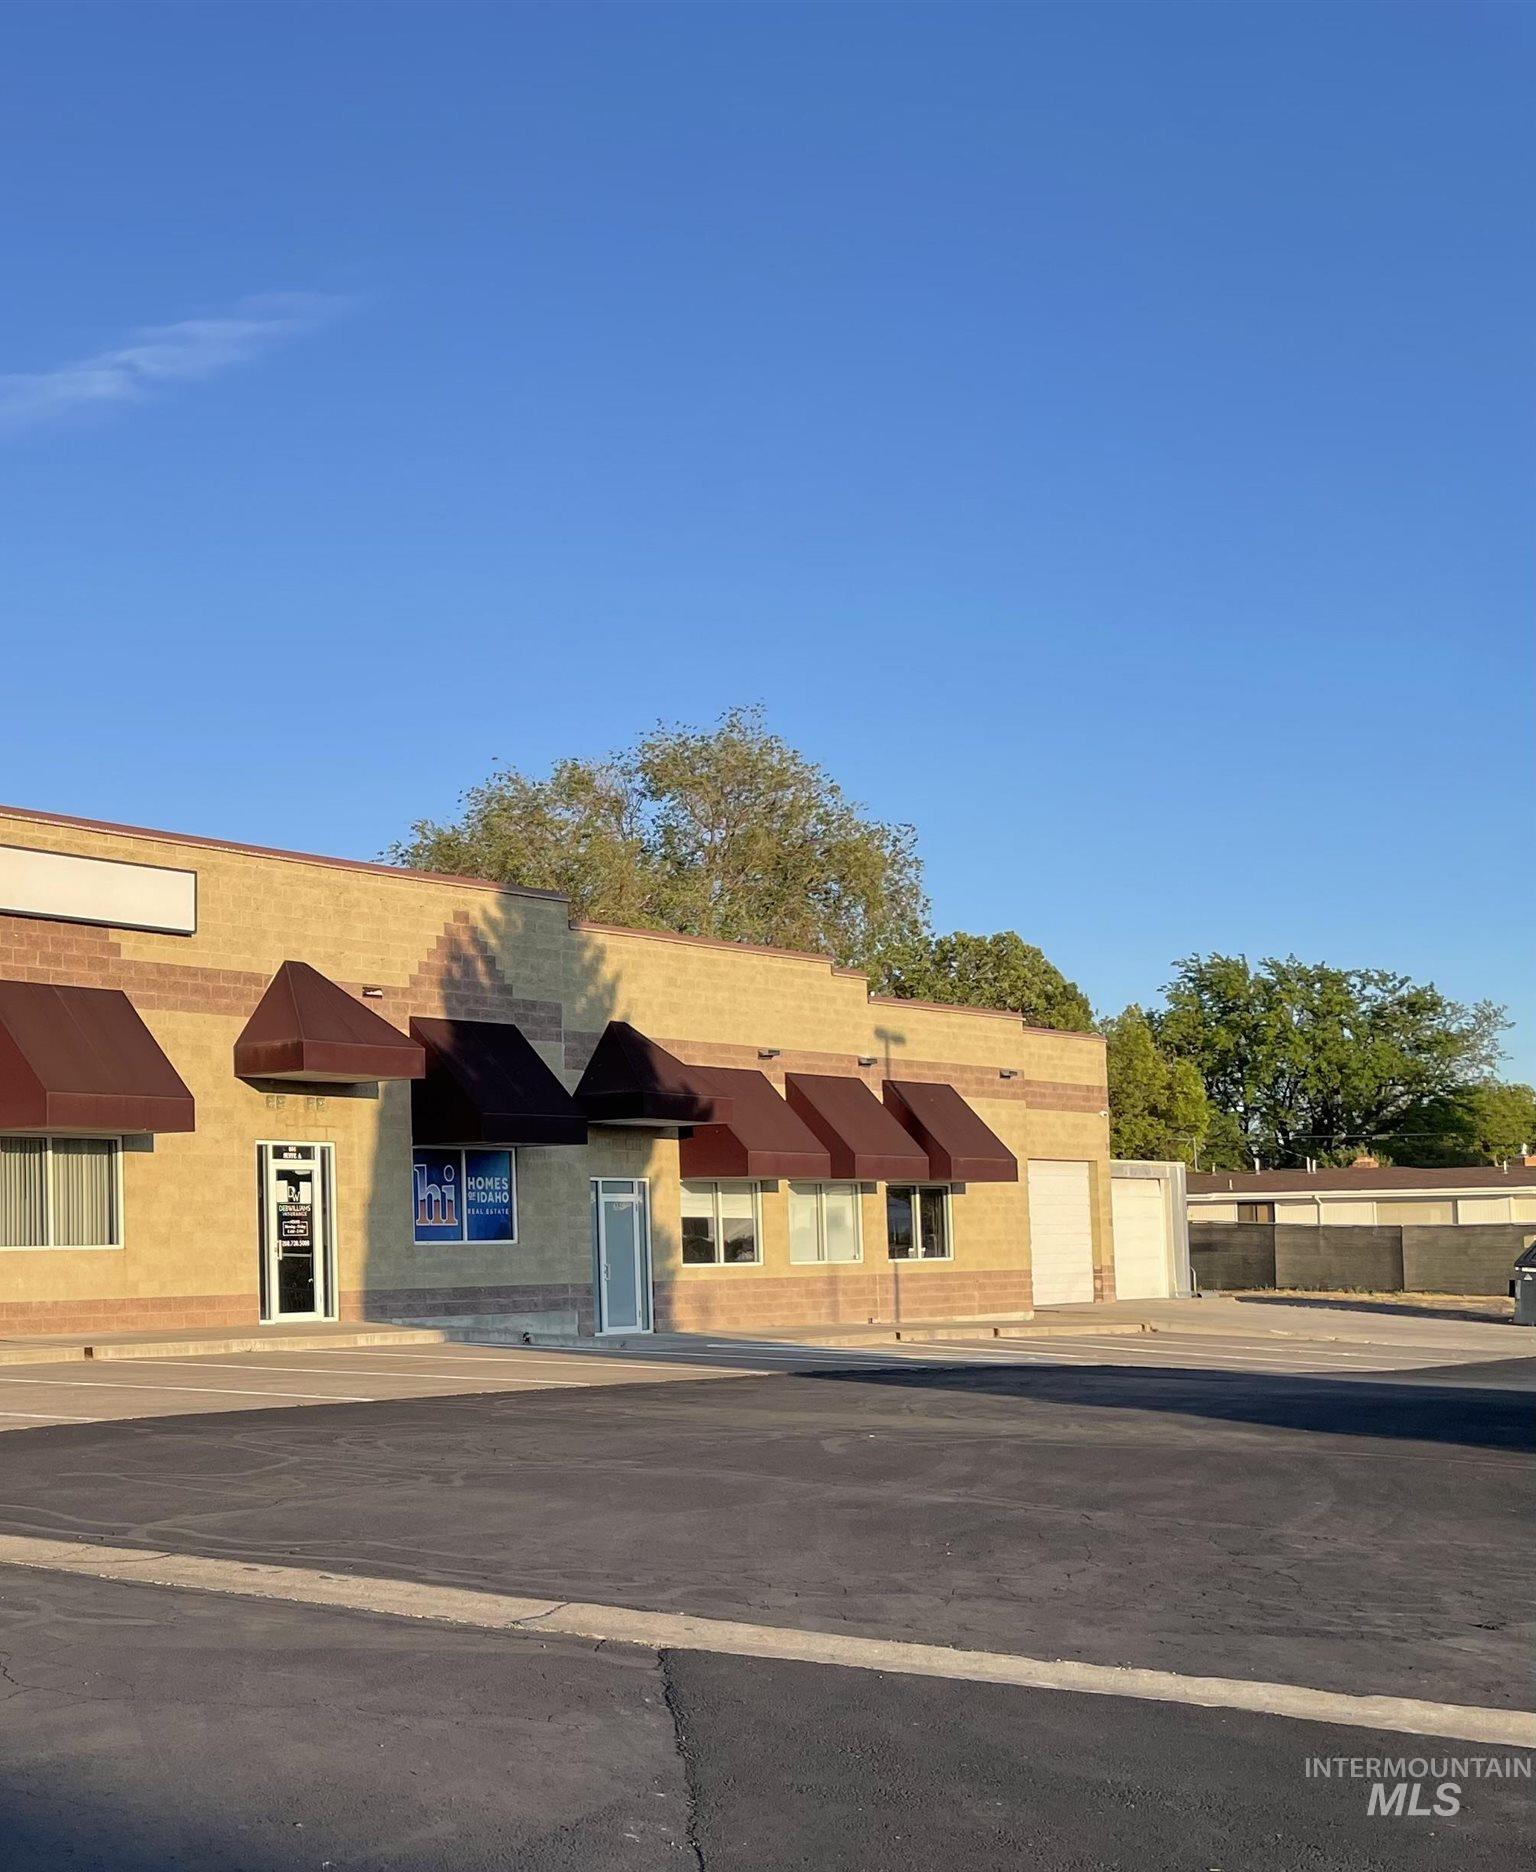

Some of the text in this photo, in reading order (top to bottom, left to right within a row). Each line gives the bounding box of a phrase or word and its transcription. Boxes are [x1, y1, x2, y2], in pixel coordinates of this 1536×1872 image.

[467, 1176, 509, 1190] HOMES
[414, 1164, 458, 1226] hi
[467, 1191, 509, 1203] OF IDAHO
